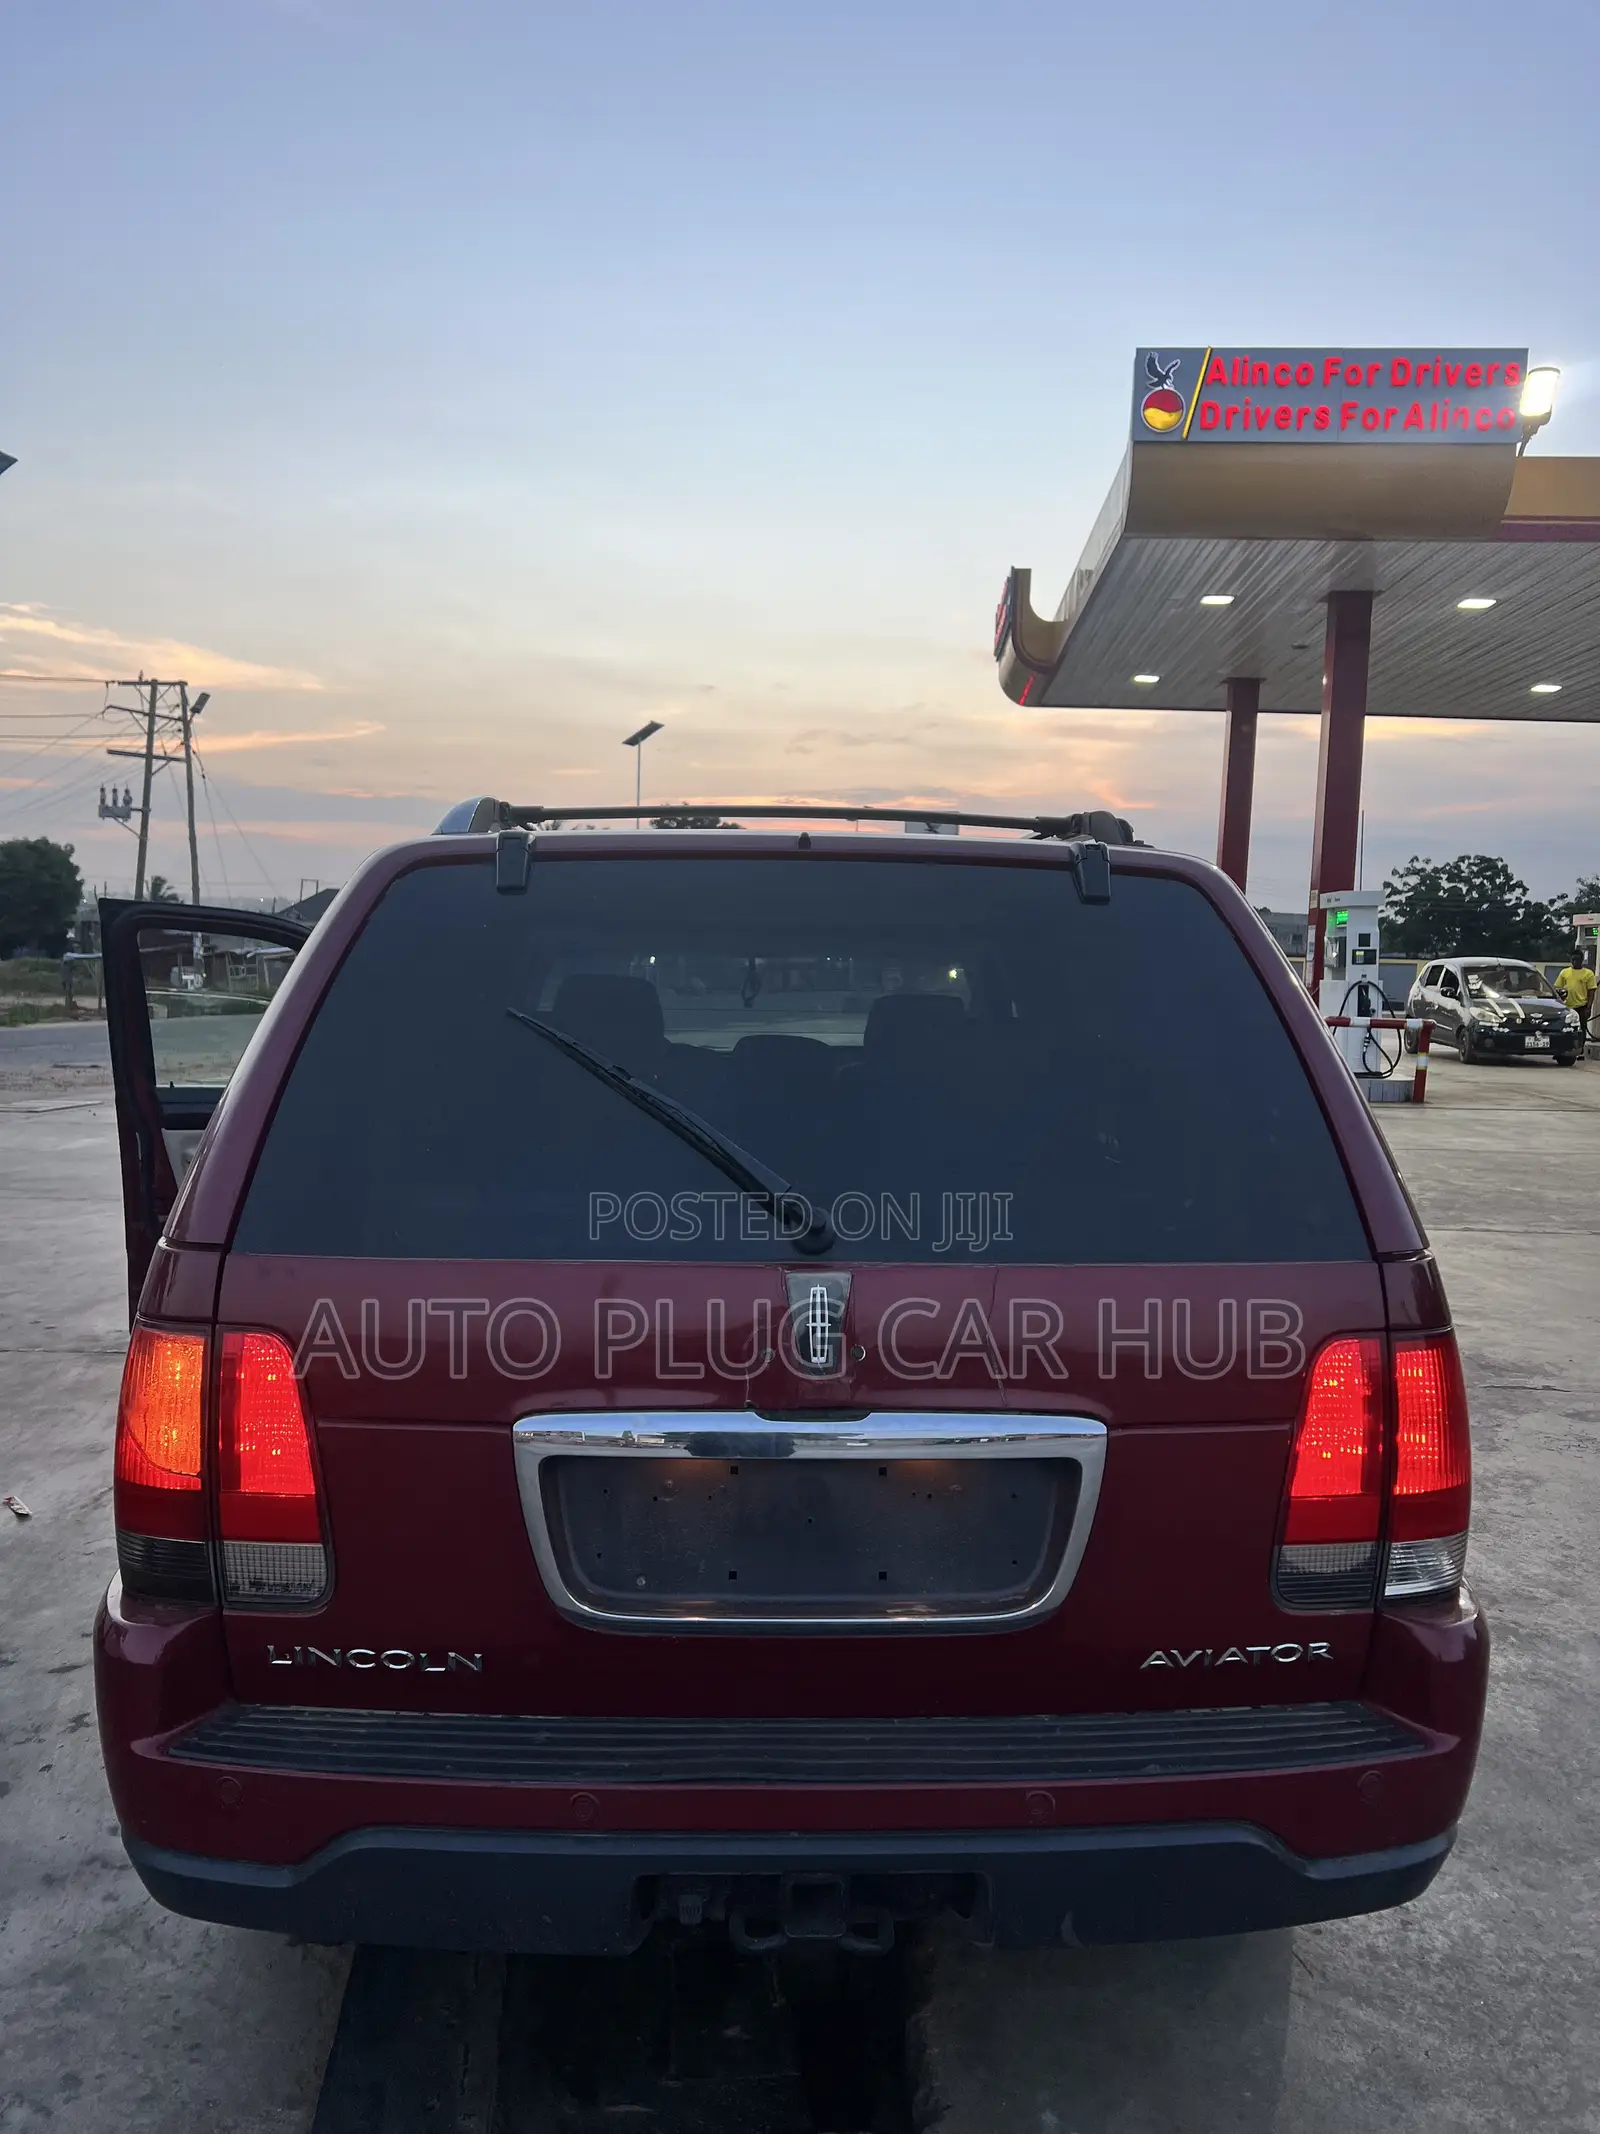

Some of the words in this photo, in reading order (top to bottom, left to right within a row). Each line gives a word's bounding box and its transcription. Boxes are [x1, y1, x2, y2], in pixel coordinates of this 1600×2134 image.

[1205, 355, 1315, 387] Alinco
[1323, 356, 1382, 387] For
[1390, 355, 1521, 387] Drivers
[1200, 397, 1332, 431] Drivers
[1340, 401, 1399, 431] For
[1403, 398, 1516, 432] Alinco
[267, 1645, 483, 1672] LINCOLN
[1139, 1642, 1334, 1669] AVIATOR
